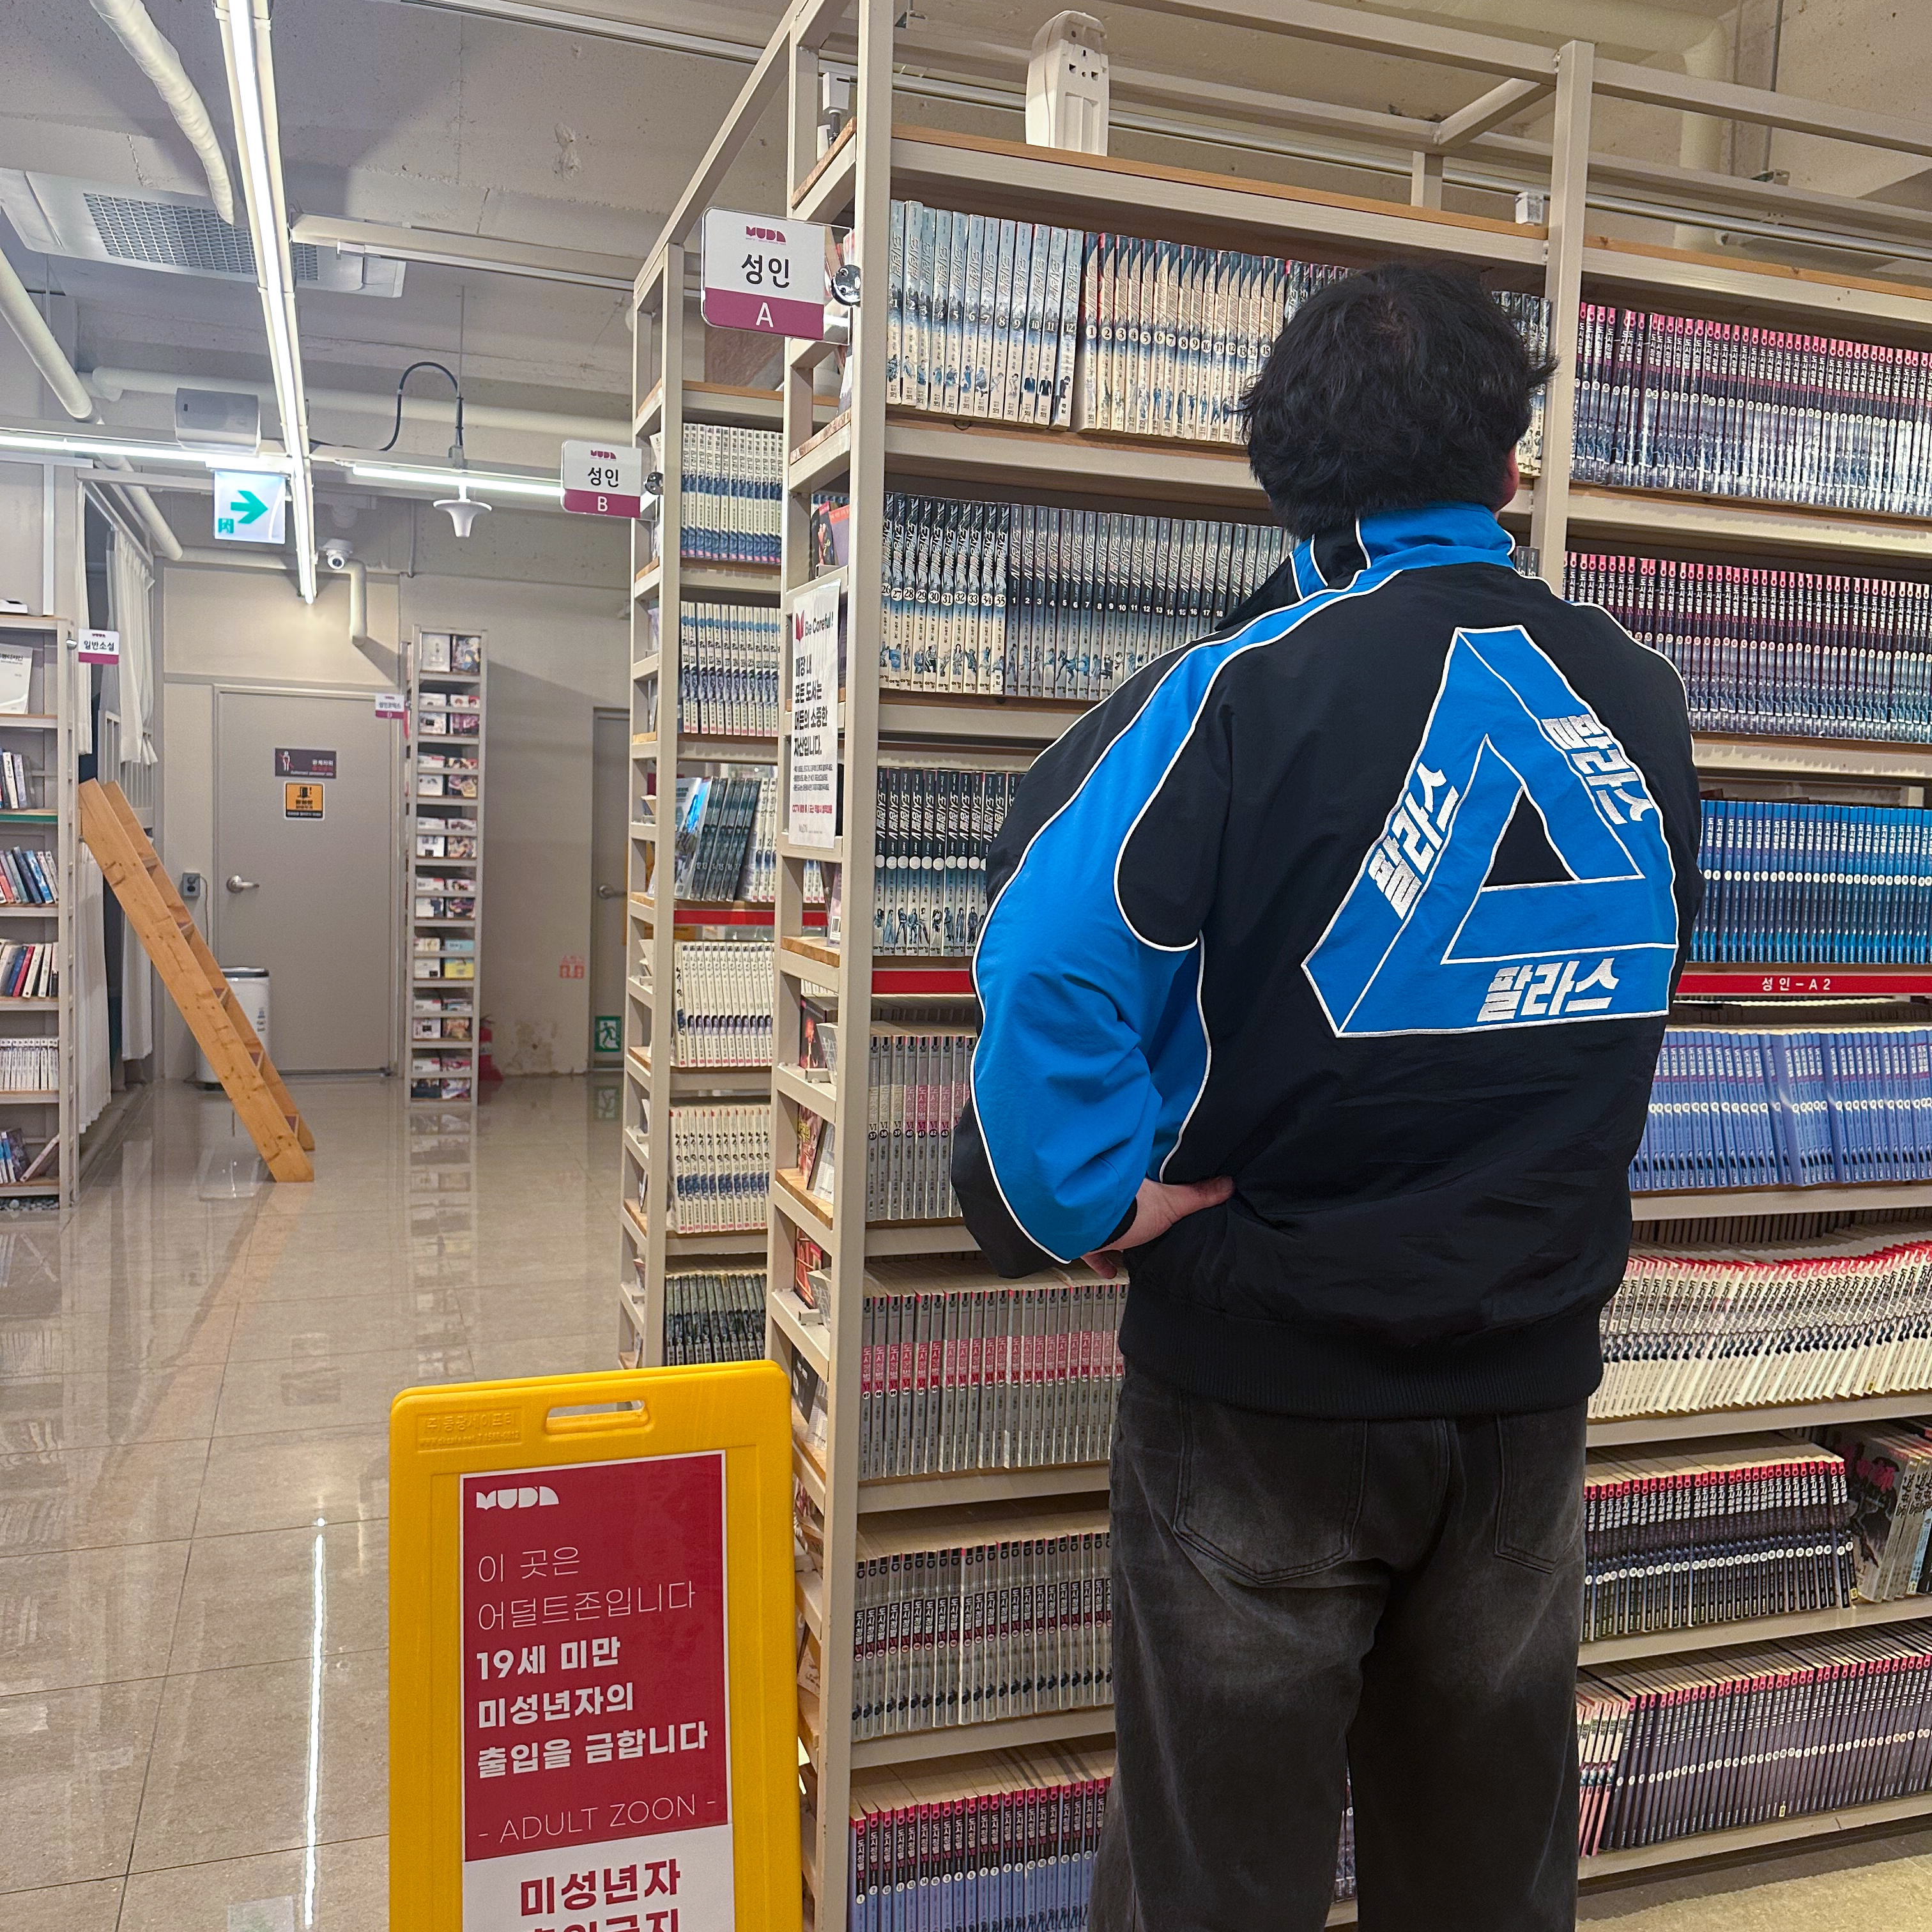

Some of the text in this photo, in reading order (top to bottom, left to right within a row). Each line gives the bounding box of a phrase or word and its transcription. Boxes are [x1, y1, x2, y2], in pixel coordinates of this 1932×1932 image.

[741, 254, 790, 288] 성인
[893, 299, 898, 307] 1
[908, 302, 916, 310] 2
[756, 302, 774, 328] A
[952, 310, 958, 319] 5
[969, 312, 975, 321] 6
[983, 314, 990, 323] 7
[999, 318, 1005, 326] 8
[1014, 320, 1020, 328] 9
[1066, 323, 1074, 332] 12
[1090, 328, 1093, 336] 1
[1105, 329, 1110, 337] 2
[1119, 330, 1124, 339] 3
[1131, 330, 1136, 338] 4
[1157, 332, 1162, 341] 6
[1169, 337, 1174, 345] 7
[1228, 344, 1235, 353] 12
[588, 467, 618, 487] 성인
[597, 496, 608, 511] B
[882, 585, 891, 594] 26
[905, 588, 914, 598] 28
[893, 590, 901, 599] 27
[917, 592, 926, 601] 29
[930, 592, 939, 601] 30
[943, 594, 952, 604] 31
[956, 592, 965, 602] 32
[969, 594, 978, 603] 33
[982, 595, 992, 605] 34
[996, 596, 1005, 605] 35
[805, 621, 811, 636] Be
[795, 679, 822, 703] 모든 도서는
[811, 705, 828, 728] 소중한
[1540, 714, 1653, 824] 팔라스
[1368, 762, 1459, 920] 팔라스
[1477, 958, 1619, 1022] 팔라스
[479, 1547, 579, 1582] 이 곳은
[479, 1580, 696, 1630] 어덜트존입니다
[477, 1637, 621, 1680] 19세 미만
[478, 1683, 634, 1729] 미성년자의
[478, 1721, 709, 1779] 출입을 금합니다
[500, 1794, 696, 1843] ADULT ZOON
[521, 1859, 680, 1916] 미성년자
